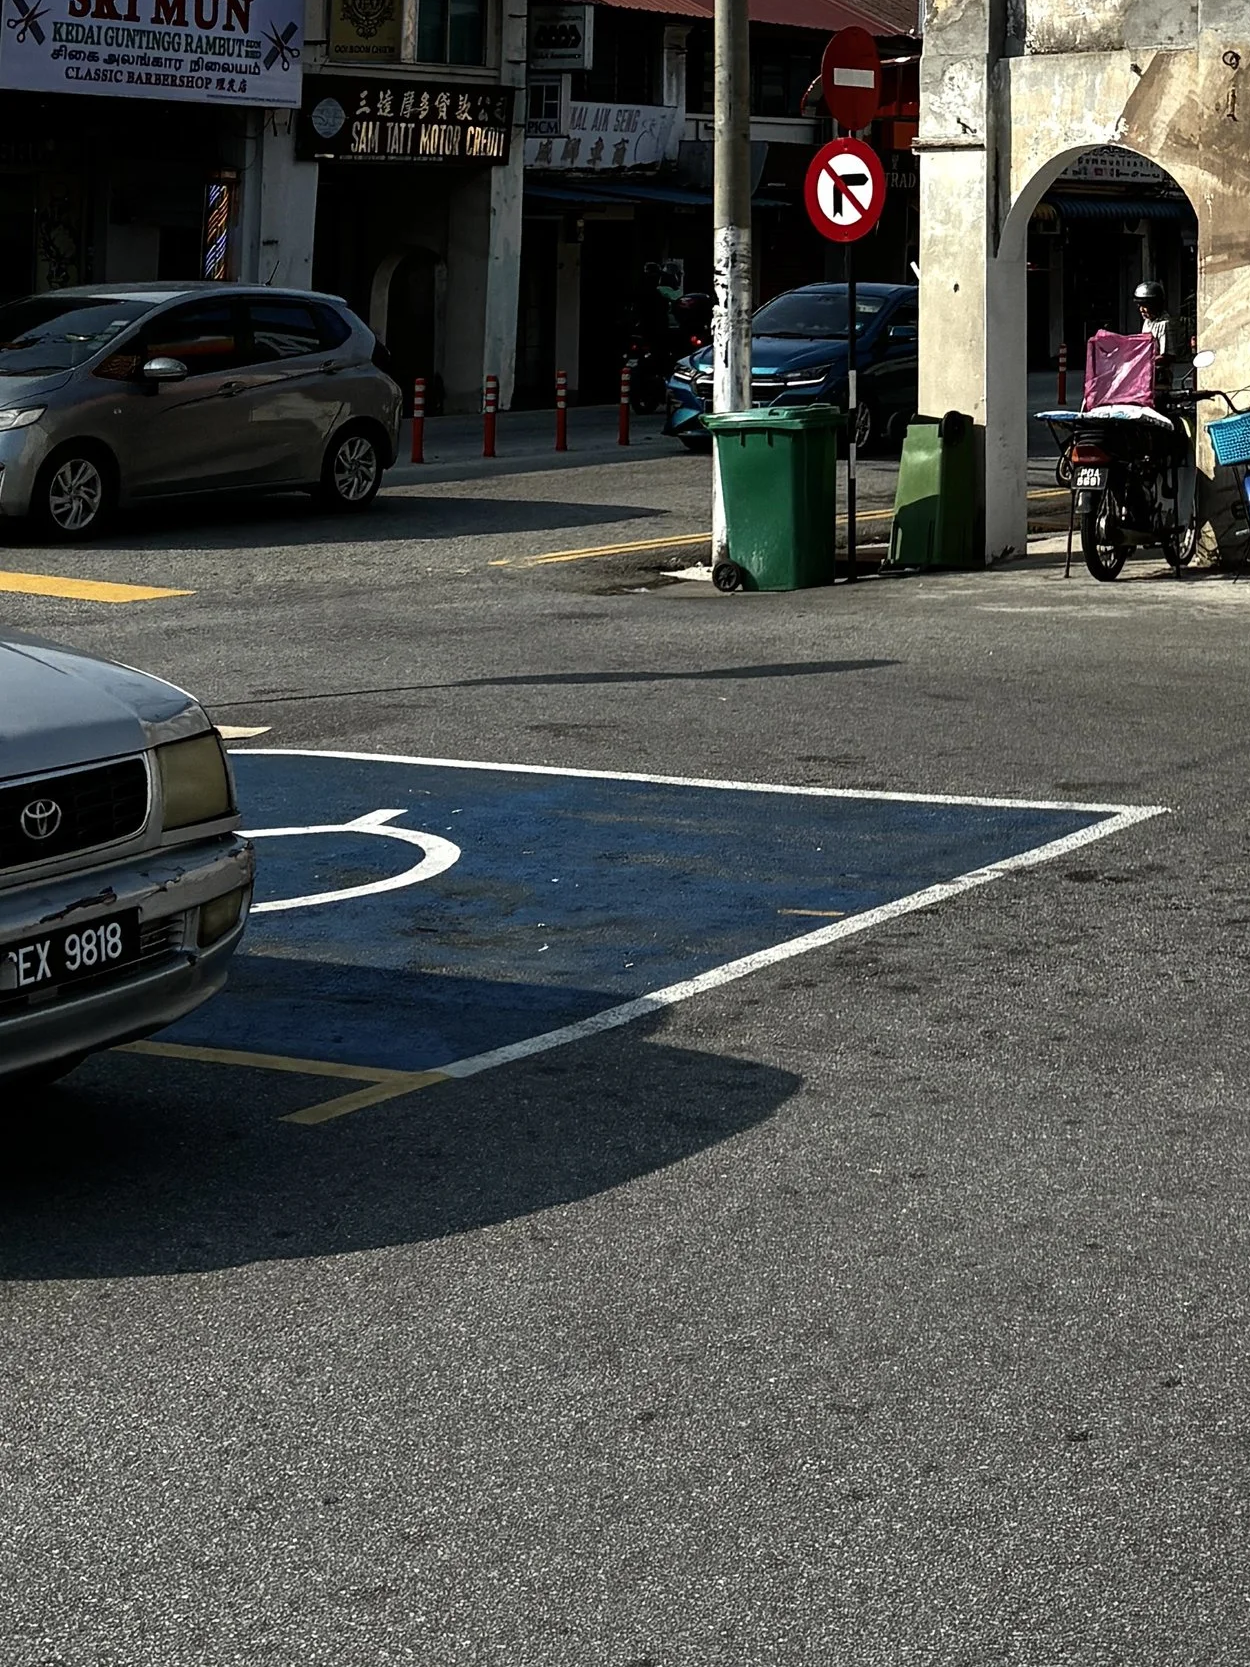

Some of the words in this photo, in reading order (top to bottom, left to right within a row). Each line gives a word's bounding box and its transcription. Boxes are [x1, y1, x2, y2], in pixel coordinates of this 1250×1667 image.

[52, 21, 103, 46] KEDAI
[104, 26, 182, 53] GUNTINGG
[184, 34, 244, 58] RAMBUT
[51, 45, 100, 61] சிகை
[103, 51, 184, 71] அலங்கார
[189, 56, 261, 76] நிலையம்
[65, 66, 123, 84] CLASSIC
[127, 72, 212, 91] BARBERSHOP
[613, 108, 641, 133] SENG
[350, 121, 380, 154] SAM
[386, 122, 415, 155] TATT
[419, 123, 462, 156] MOTOR
[465, 125, 507, 158] CREDIT
[64, 922, 122, 971] 9818
